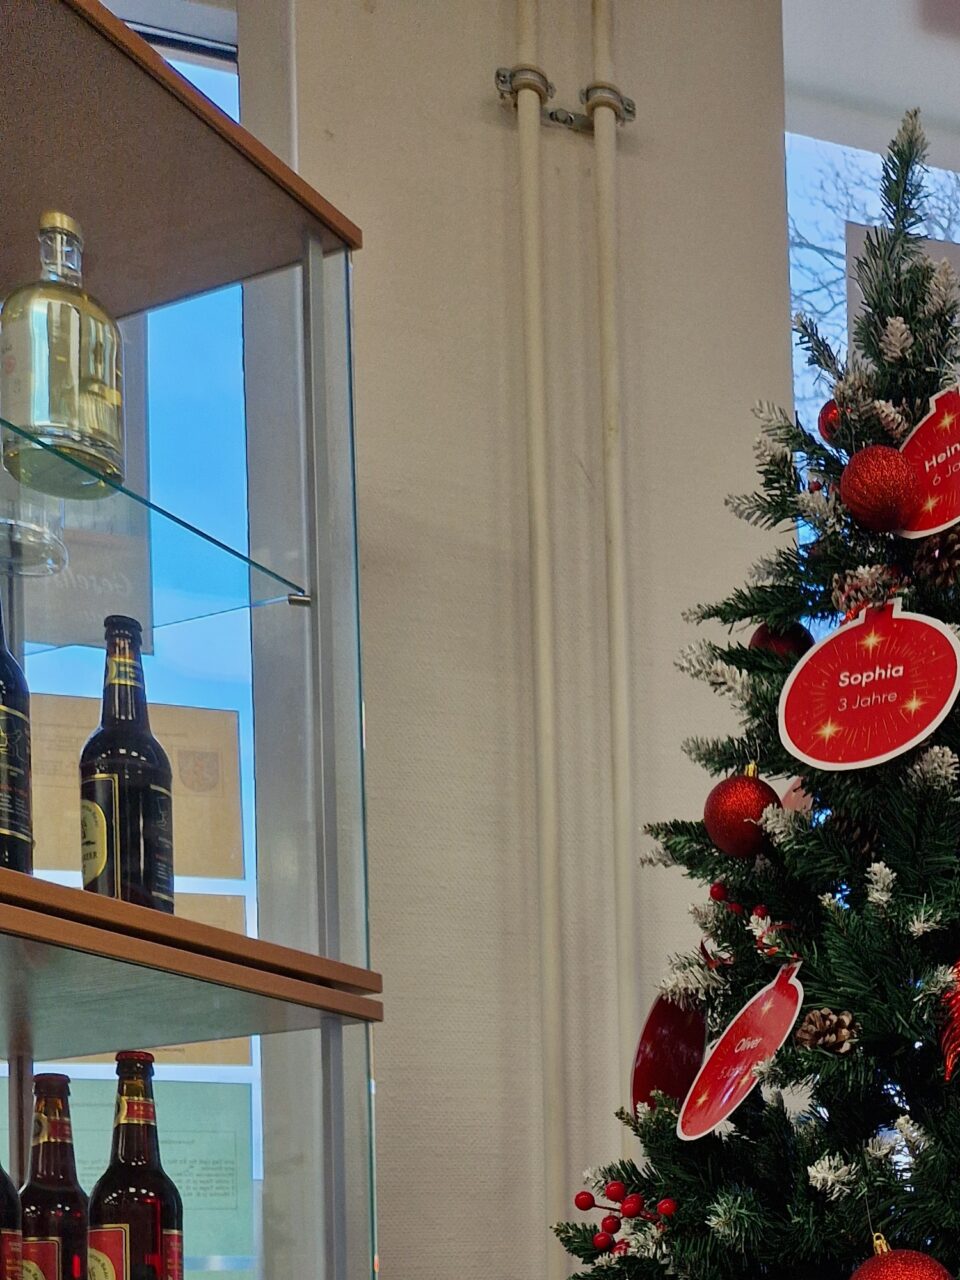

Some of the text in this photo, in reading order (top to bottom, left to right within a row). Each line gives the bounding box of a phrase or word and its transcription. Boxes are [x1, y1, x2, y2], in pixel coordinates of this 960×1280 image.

[932, 474, 941, 487] 6
[838, 663, 904, 688] Sophia
[838, 691, 897, 712] 3 Jahre
